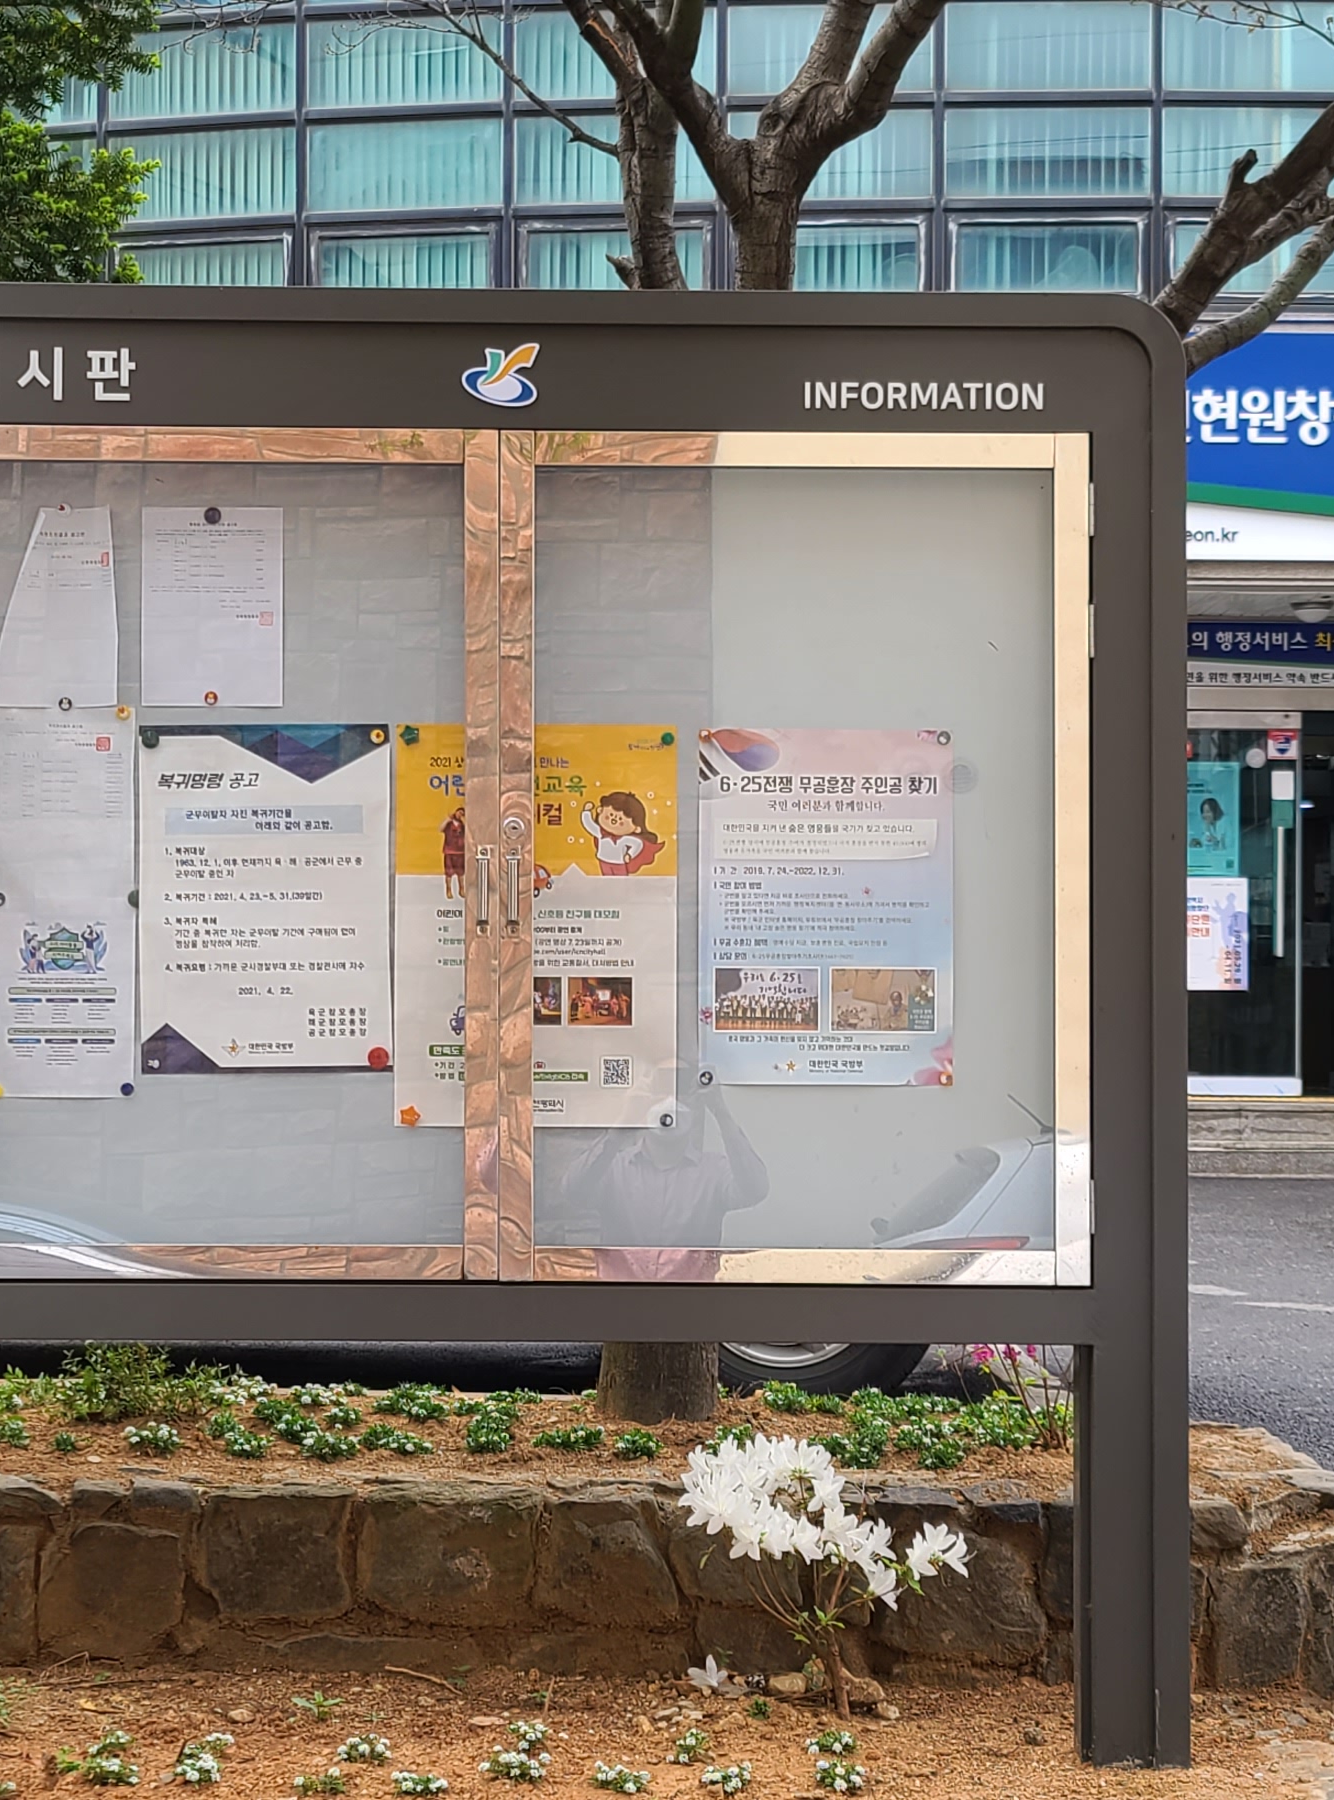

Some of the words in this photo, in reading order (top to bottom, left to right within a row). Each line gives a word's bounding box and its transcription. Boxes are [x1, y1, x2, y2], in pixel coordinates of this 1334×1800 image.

[804, 381, 1046, 412] INFORMATION
[1215, 631, 1308, 652] 행정서비스
[1208, 671, 1228, 684] 위한
[1231, 671, 1284, 684] 행정서비스
[1285, 672, 1306, 684] 약속
[430, 757, 452, 768] 2021
[540, 757, 570, 769] 만나는
[157, 772, 224, 790] 복귀명령
[229, 772, 260, 789] 공고
[799, 775, 856, 795] 무공훈장
[861, 775, 903, 794] 주인공
[908, 775, 938, 795] 찾기
[767, 800, 788, 812] 국민
[284, 820, 301, 831] 같이
[722, 823, 760, 833] 대한민국을
[808, 1060, 838, 1069] 대한민국
[841, 1060, 864, 1069] 국방부
